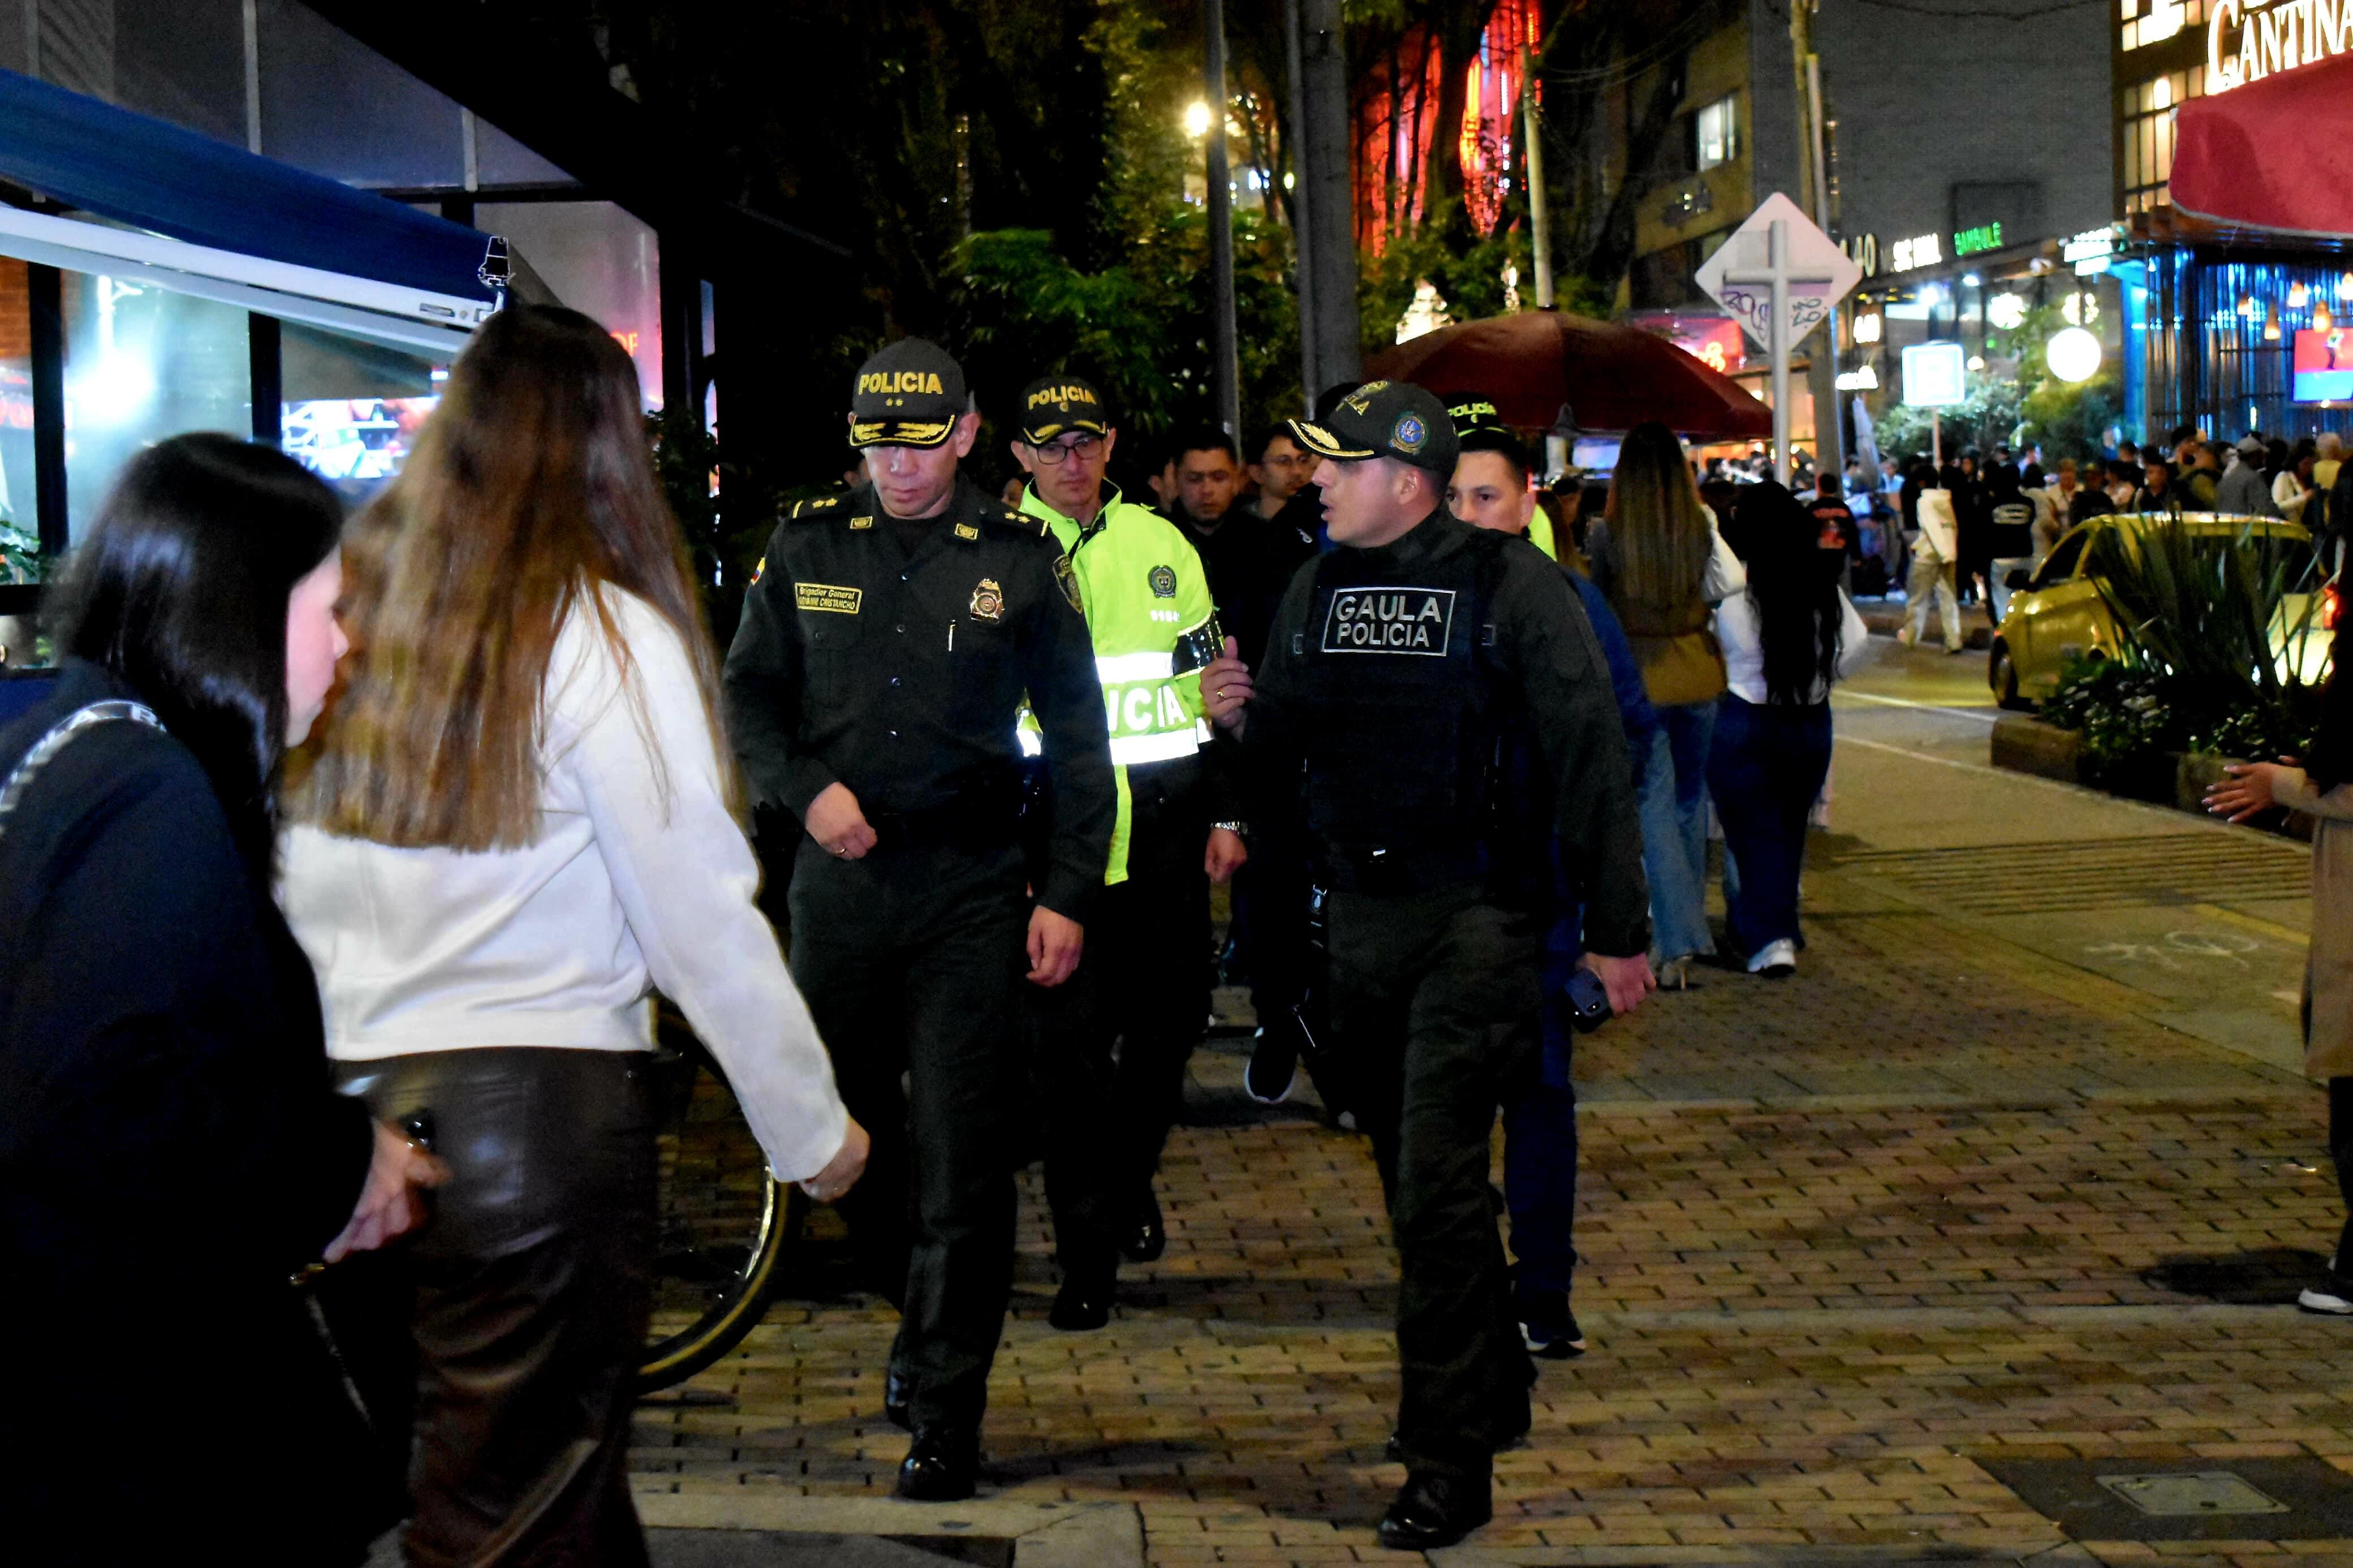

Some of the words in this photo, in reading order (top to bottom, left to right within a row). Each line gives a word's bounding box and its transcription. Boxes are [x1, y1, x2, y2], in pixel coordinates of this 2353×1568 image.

[2205, 0, 2353, 95] CANTINA
[858, 372, 943, 395] POLICIA
[1028, 385, 1097, 410] POLICIA
[799, 587, 827, 597] Brigadier
[828, 589, 855, 600] General
[820, 598, 855, 610] CRISTANCHO
[1335, 595, 1442, 623] GAULA
[1337, 622, 1430, 648] POLICIA
[1106, 685, 1187, 732] ICIA
